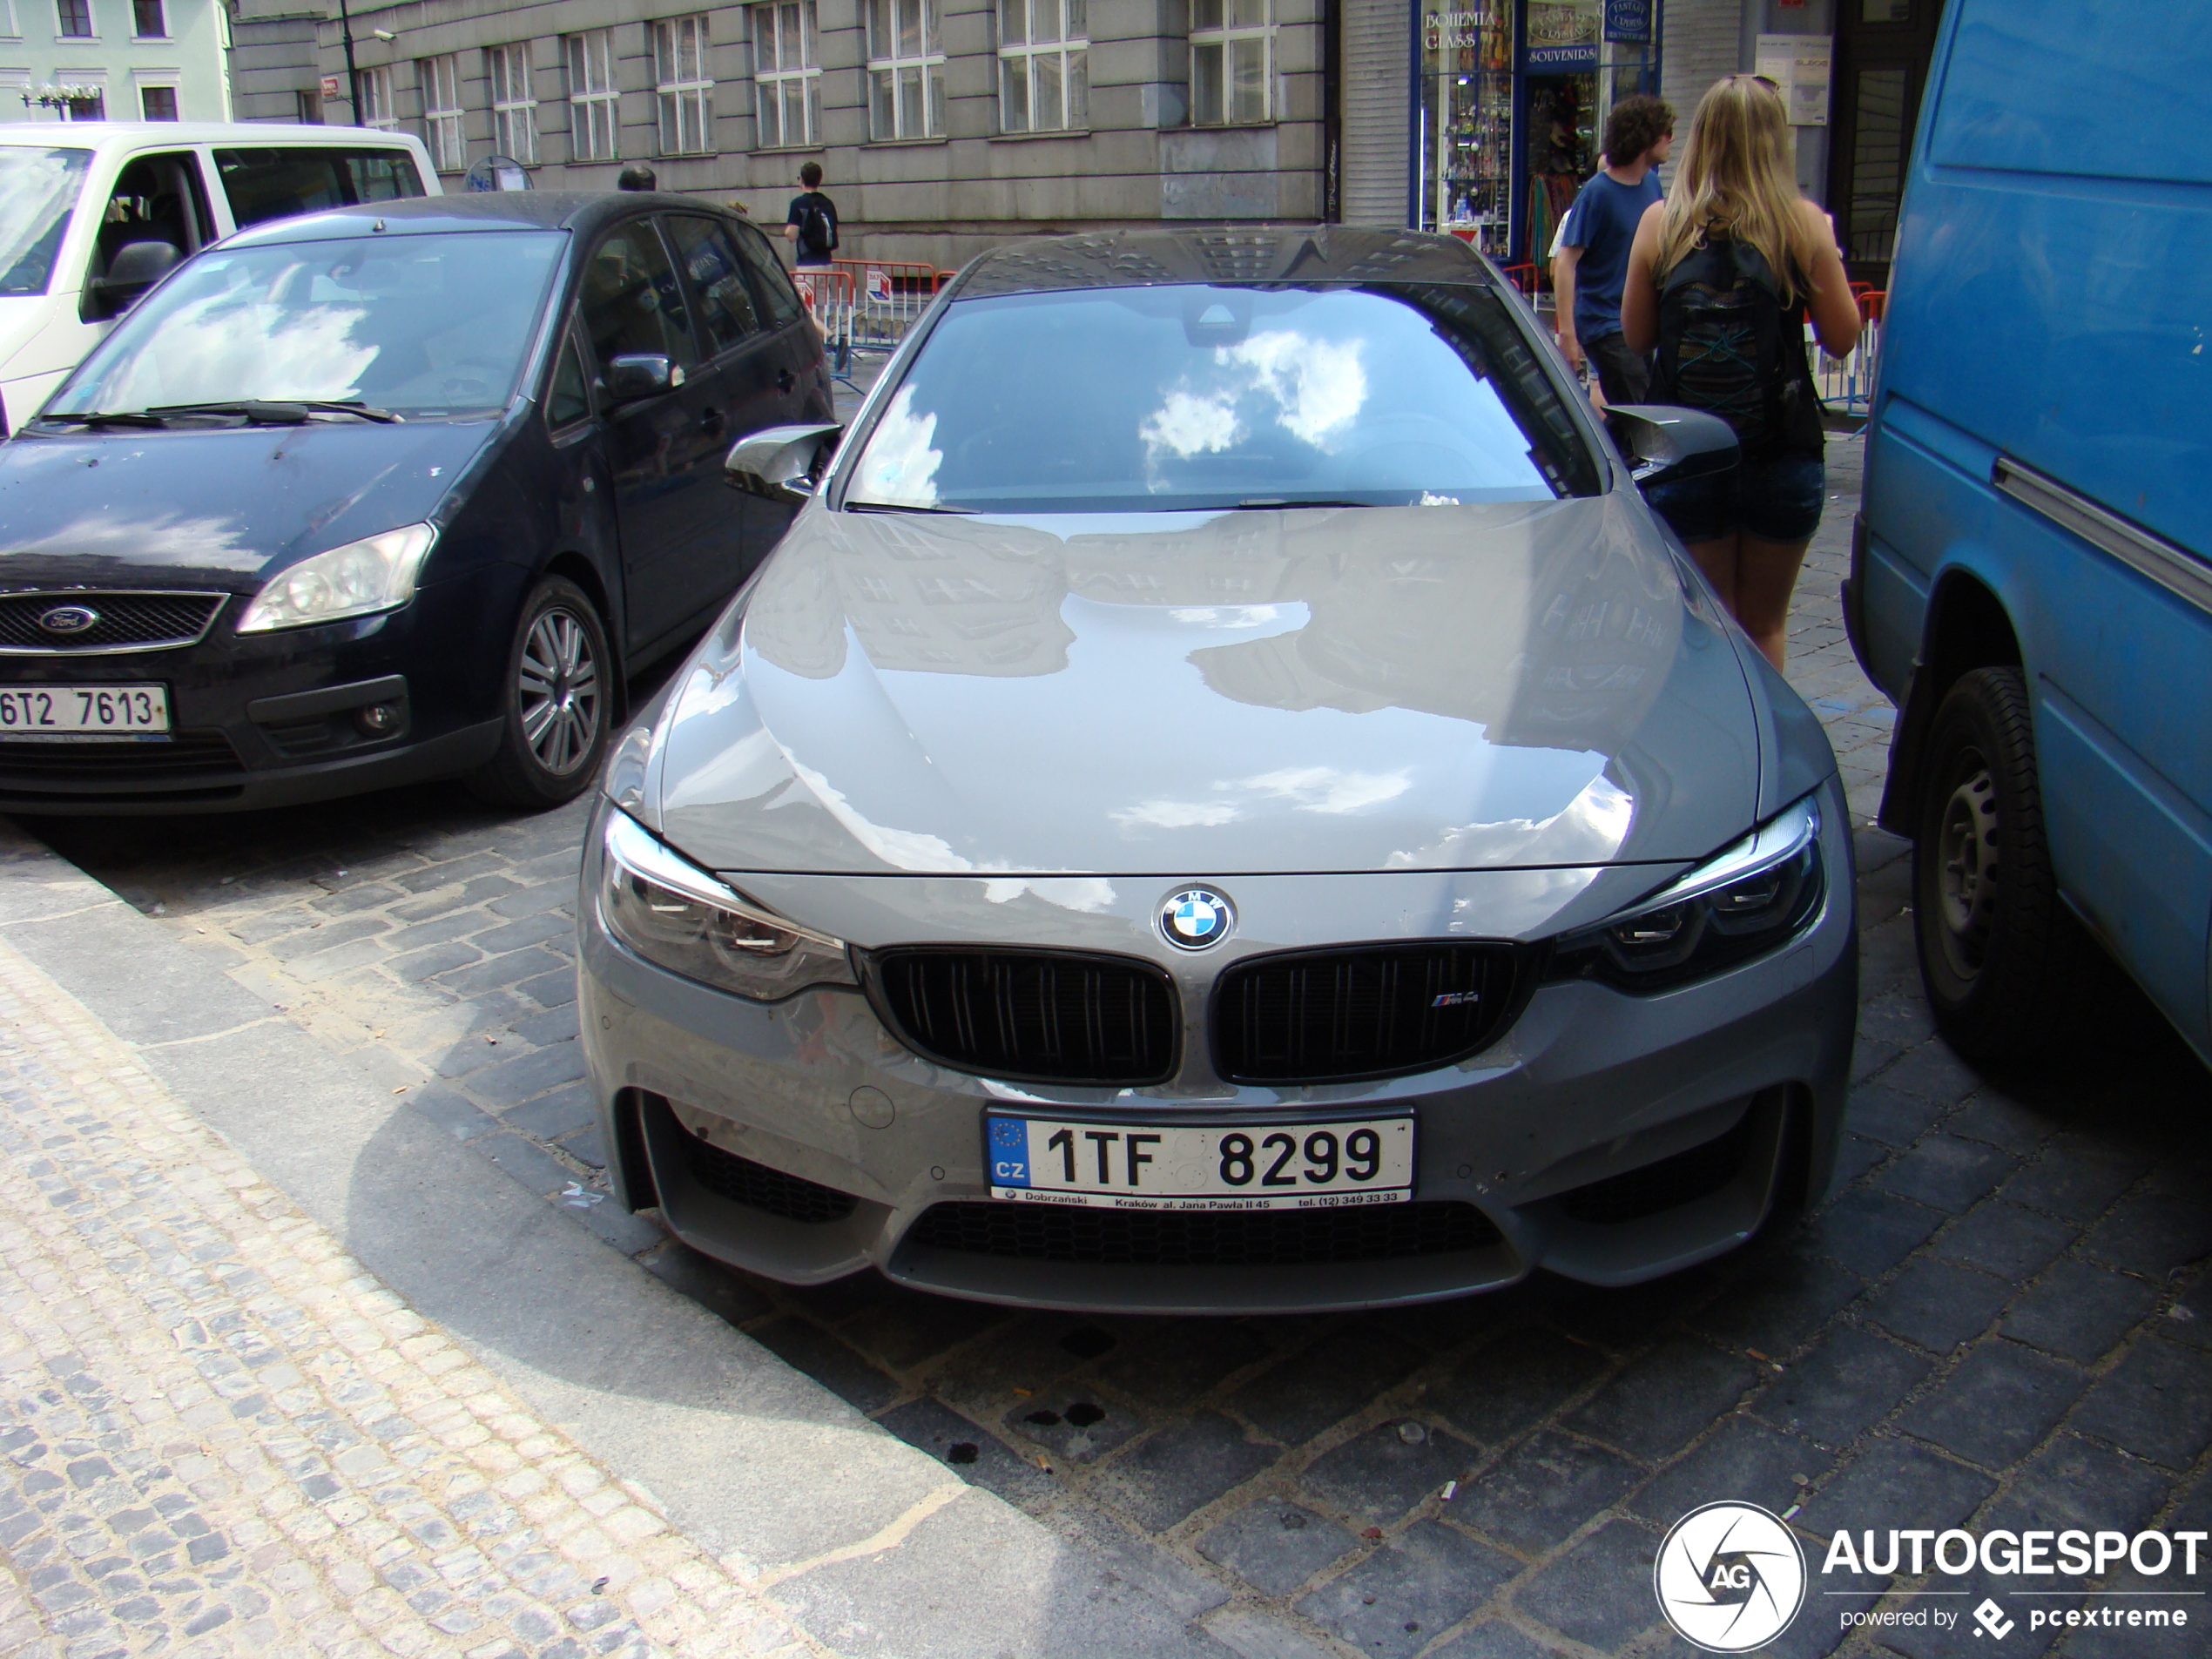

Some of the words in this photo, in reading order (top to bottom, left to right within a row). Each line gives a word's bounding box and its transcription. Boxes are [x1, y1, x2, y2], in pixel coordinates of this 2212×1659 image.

[1613, 2, 1645, 15] FANTASY
[1426, 11, 1495, 28] BOHEMIA
[1426, 33, 1475, 50] GLASS
[1529, 49, 1595, 63] SOUVENIRS
[51, 613, 79, 627] Ford
[0, 692, 55, 725] 6T2
[77, 692, 152, 725] 7613
[1048, 1129, 1161, 1186] 1TF
[1219, 1129, 1380, 1186] 8299
[995, 1161, 1025, 1178] CZ
[1025, 1191, 1088, 1204] Dobrzański
[1115, 1198, 1157, 1209] Kraków
[1179, 1201, 1206, 1210] Jana
[1318, 1197, 1339, 1207] (12)
[1342, 1195, 1364, 1204] 349
[1366, 1194, 1380, 1203] 33
[1383, 1193, 1398, 1202] 33
